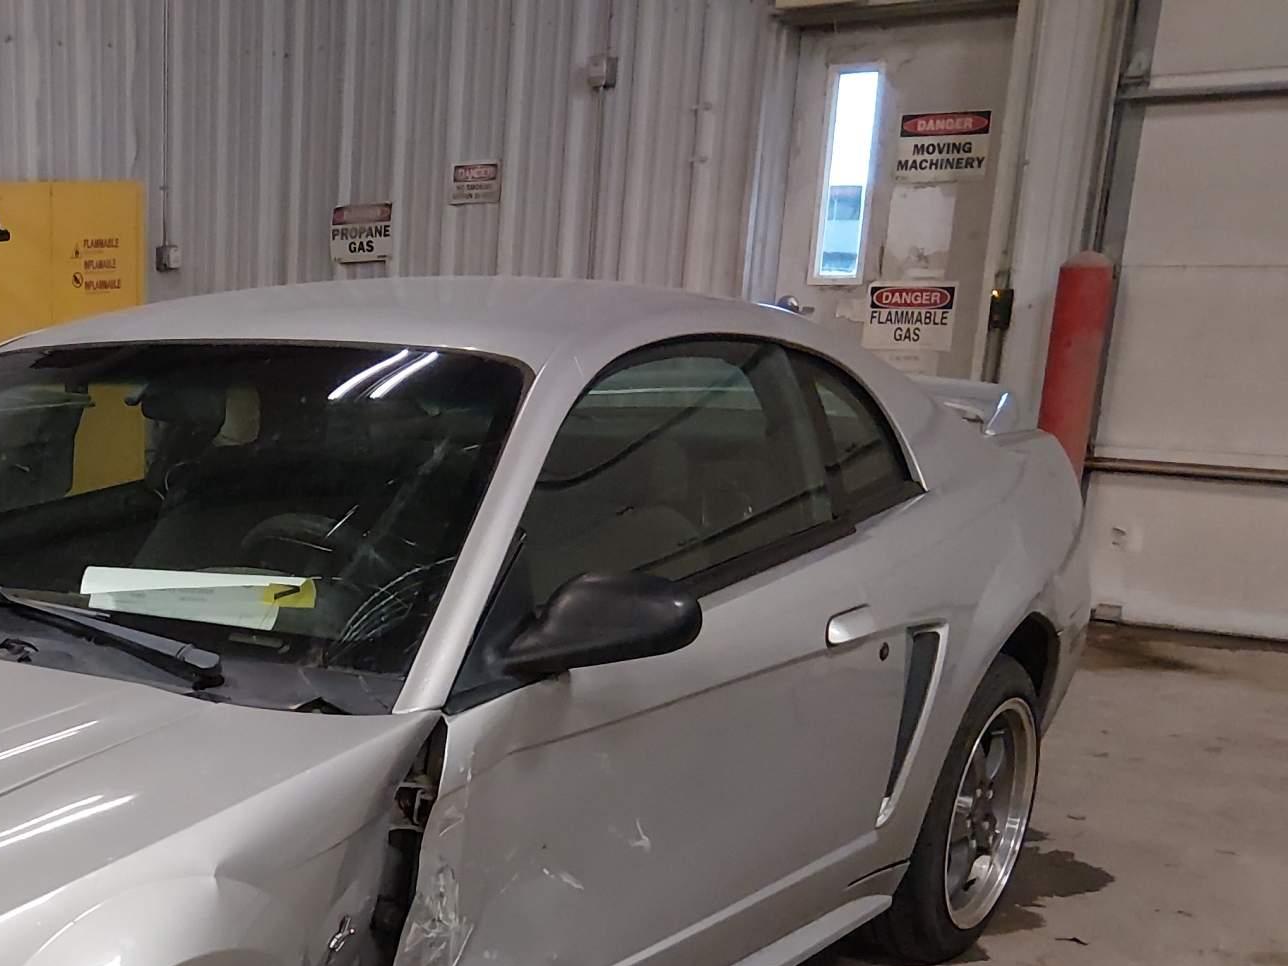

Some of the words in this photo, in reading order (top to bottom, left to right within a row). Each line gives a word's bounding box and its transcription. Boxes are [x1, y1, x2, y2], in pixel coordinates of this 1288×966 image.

[917, 118, 973, 131] DANGER
[912, 142, 972, 155] MOVING
[896, 157, 985, 171] MACHINERY
[332, 225, 390, 240] PROPANE
[348, 240, 374, 253] GAS
[882, 292, 941, 304] DANGER
[870, 311, 949, 325] FLAMMABLE
[894, 327, 920, 342] GAS
